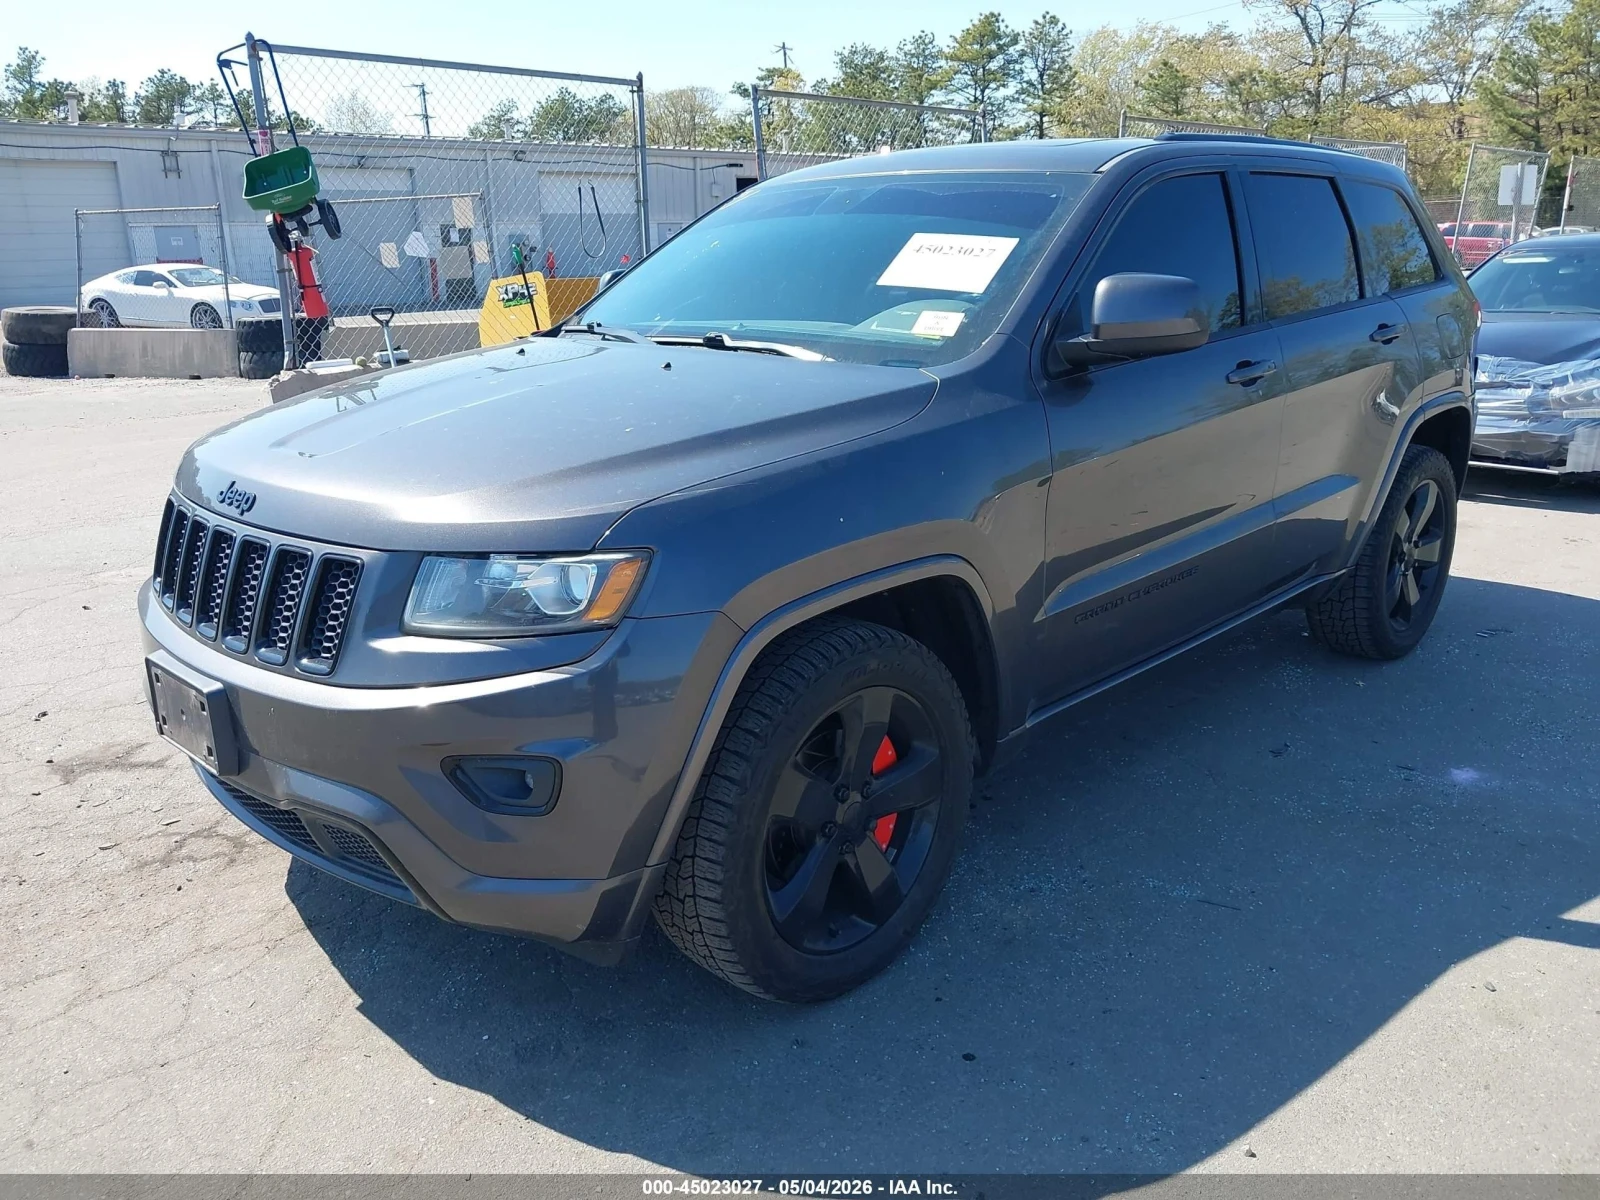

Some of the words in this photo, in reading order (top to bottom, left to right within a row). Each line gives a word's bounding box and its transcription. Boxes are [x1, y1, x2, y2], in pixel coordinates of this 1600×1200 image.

[913, 244, 996, 257] 45023027
[217, 480, 256, 516] Jeep
[1074, 596, 1124, 624] GRAND
[1128, 565, 1199, 602] CHEROKEE
